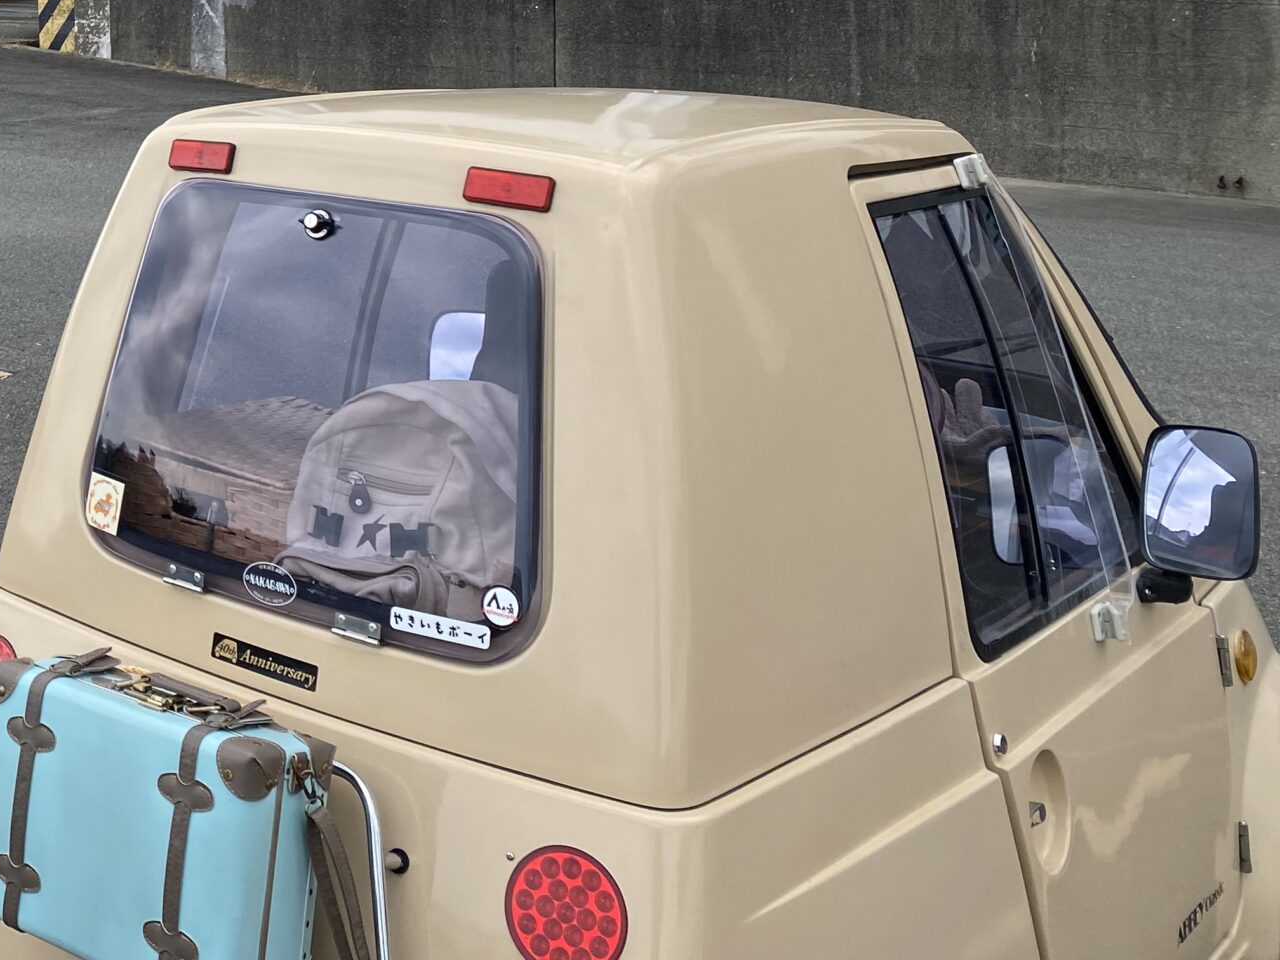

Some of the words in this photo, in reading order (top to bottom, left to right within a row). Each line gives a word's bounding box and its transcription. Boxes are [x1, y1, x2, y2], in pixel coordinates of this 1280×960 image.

[249, 573, 291, 596] NAKAGAWA
[393, 611, 488, 644] やきいもボーイ
[240, 649, 316, 689] Anniversary
